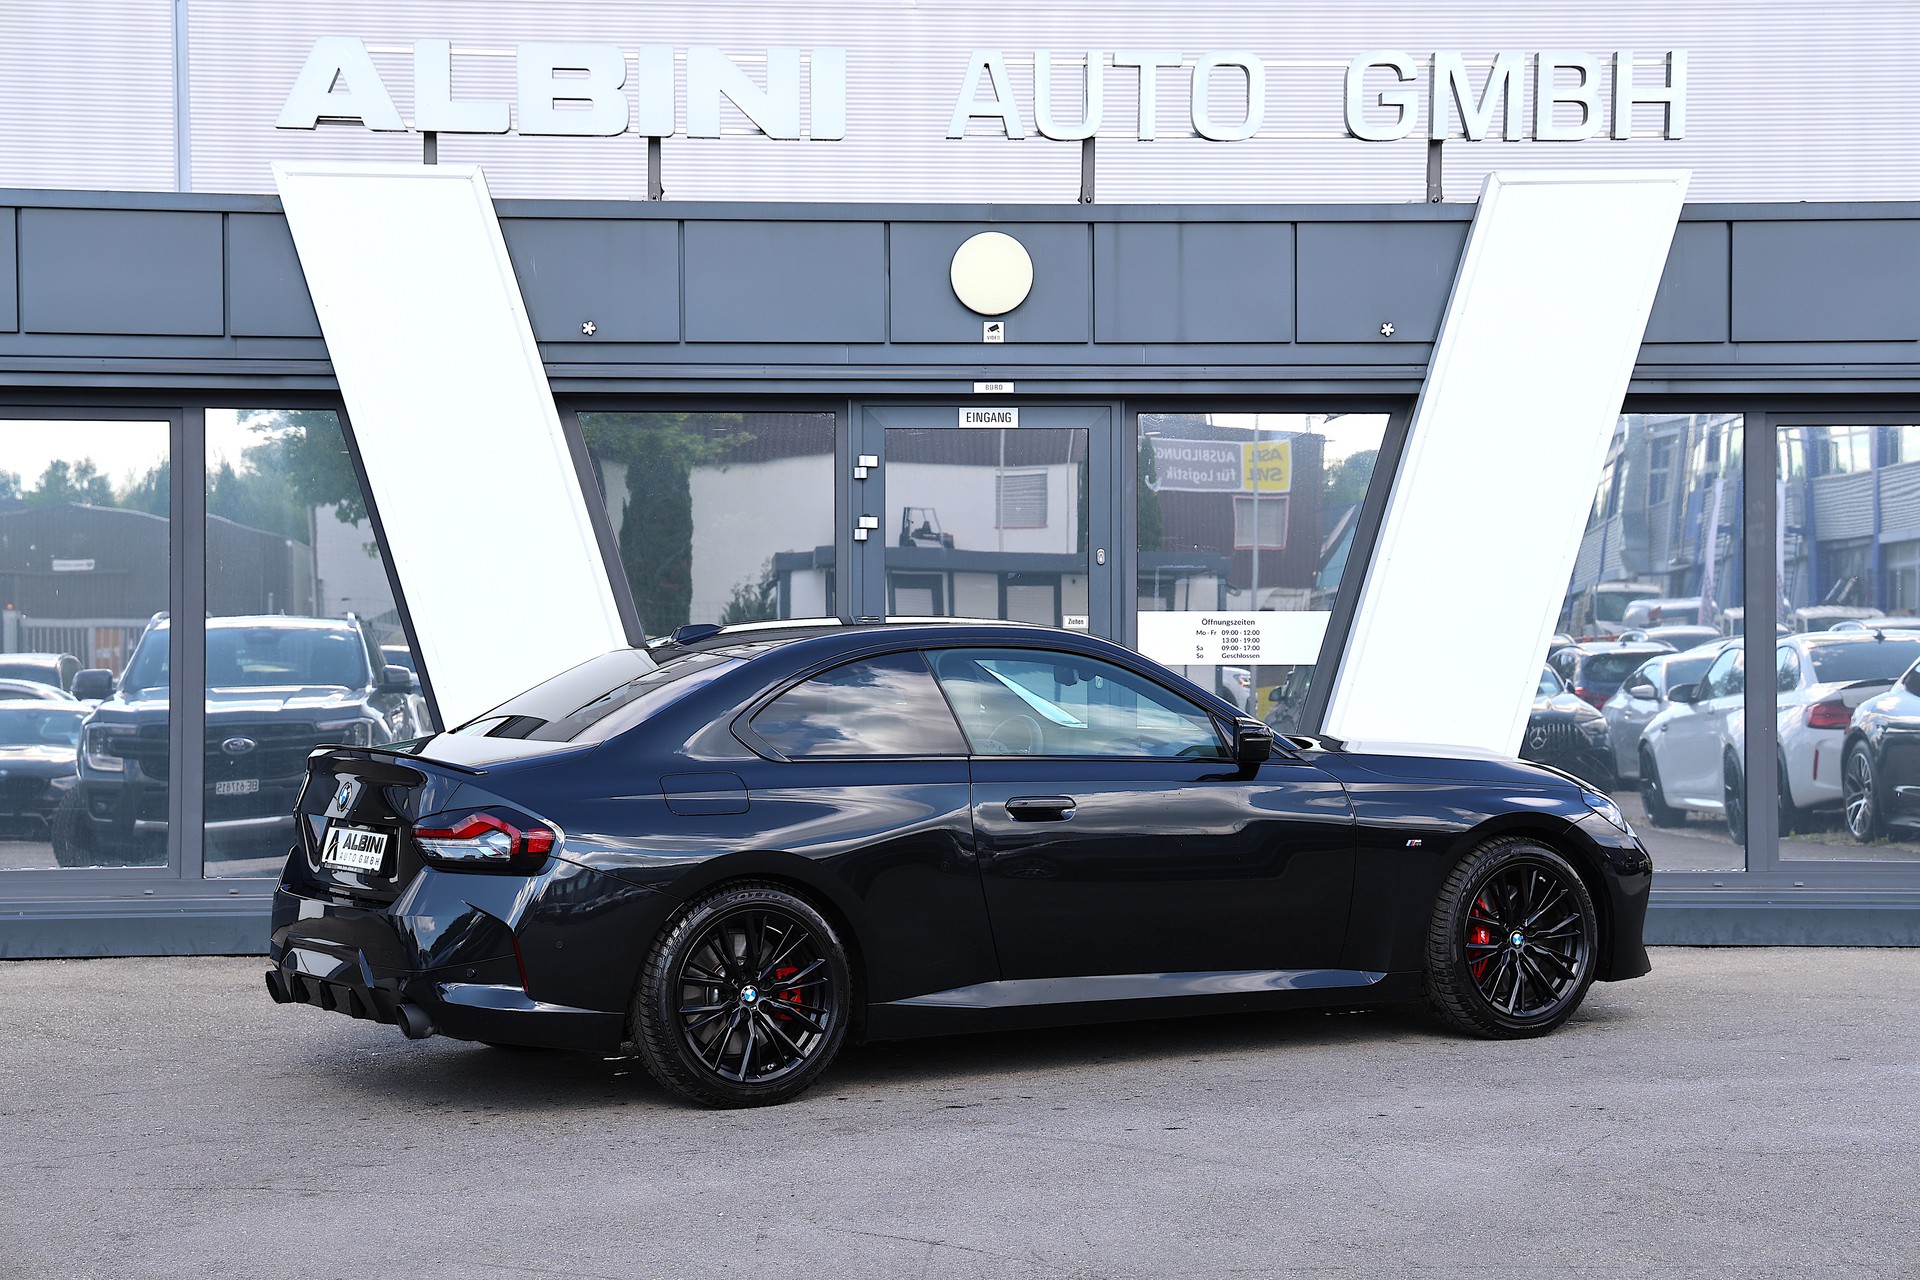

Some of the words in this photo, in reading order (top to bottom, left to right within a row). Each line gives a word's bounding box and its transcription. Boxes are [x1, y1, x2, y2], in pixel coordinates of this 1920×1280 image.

[274, 36, 847, 141] ALBINI
[945, 49, 1266, 142] AUTO
[1343, 48, 1689, 142] GMBH
[966, 412, 1012, 423] EINGANG
[1201, 617, 1256, 627] Öffnungszeiten
[342, 833, 385, 854] ALBINI
[339, 851, 357, 862] AUTO
[358, 854, 380, 866] GMBH
